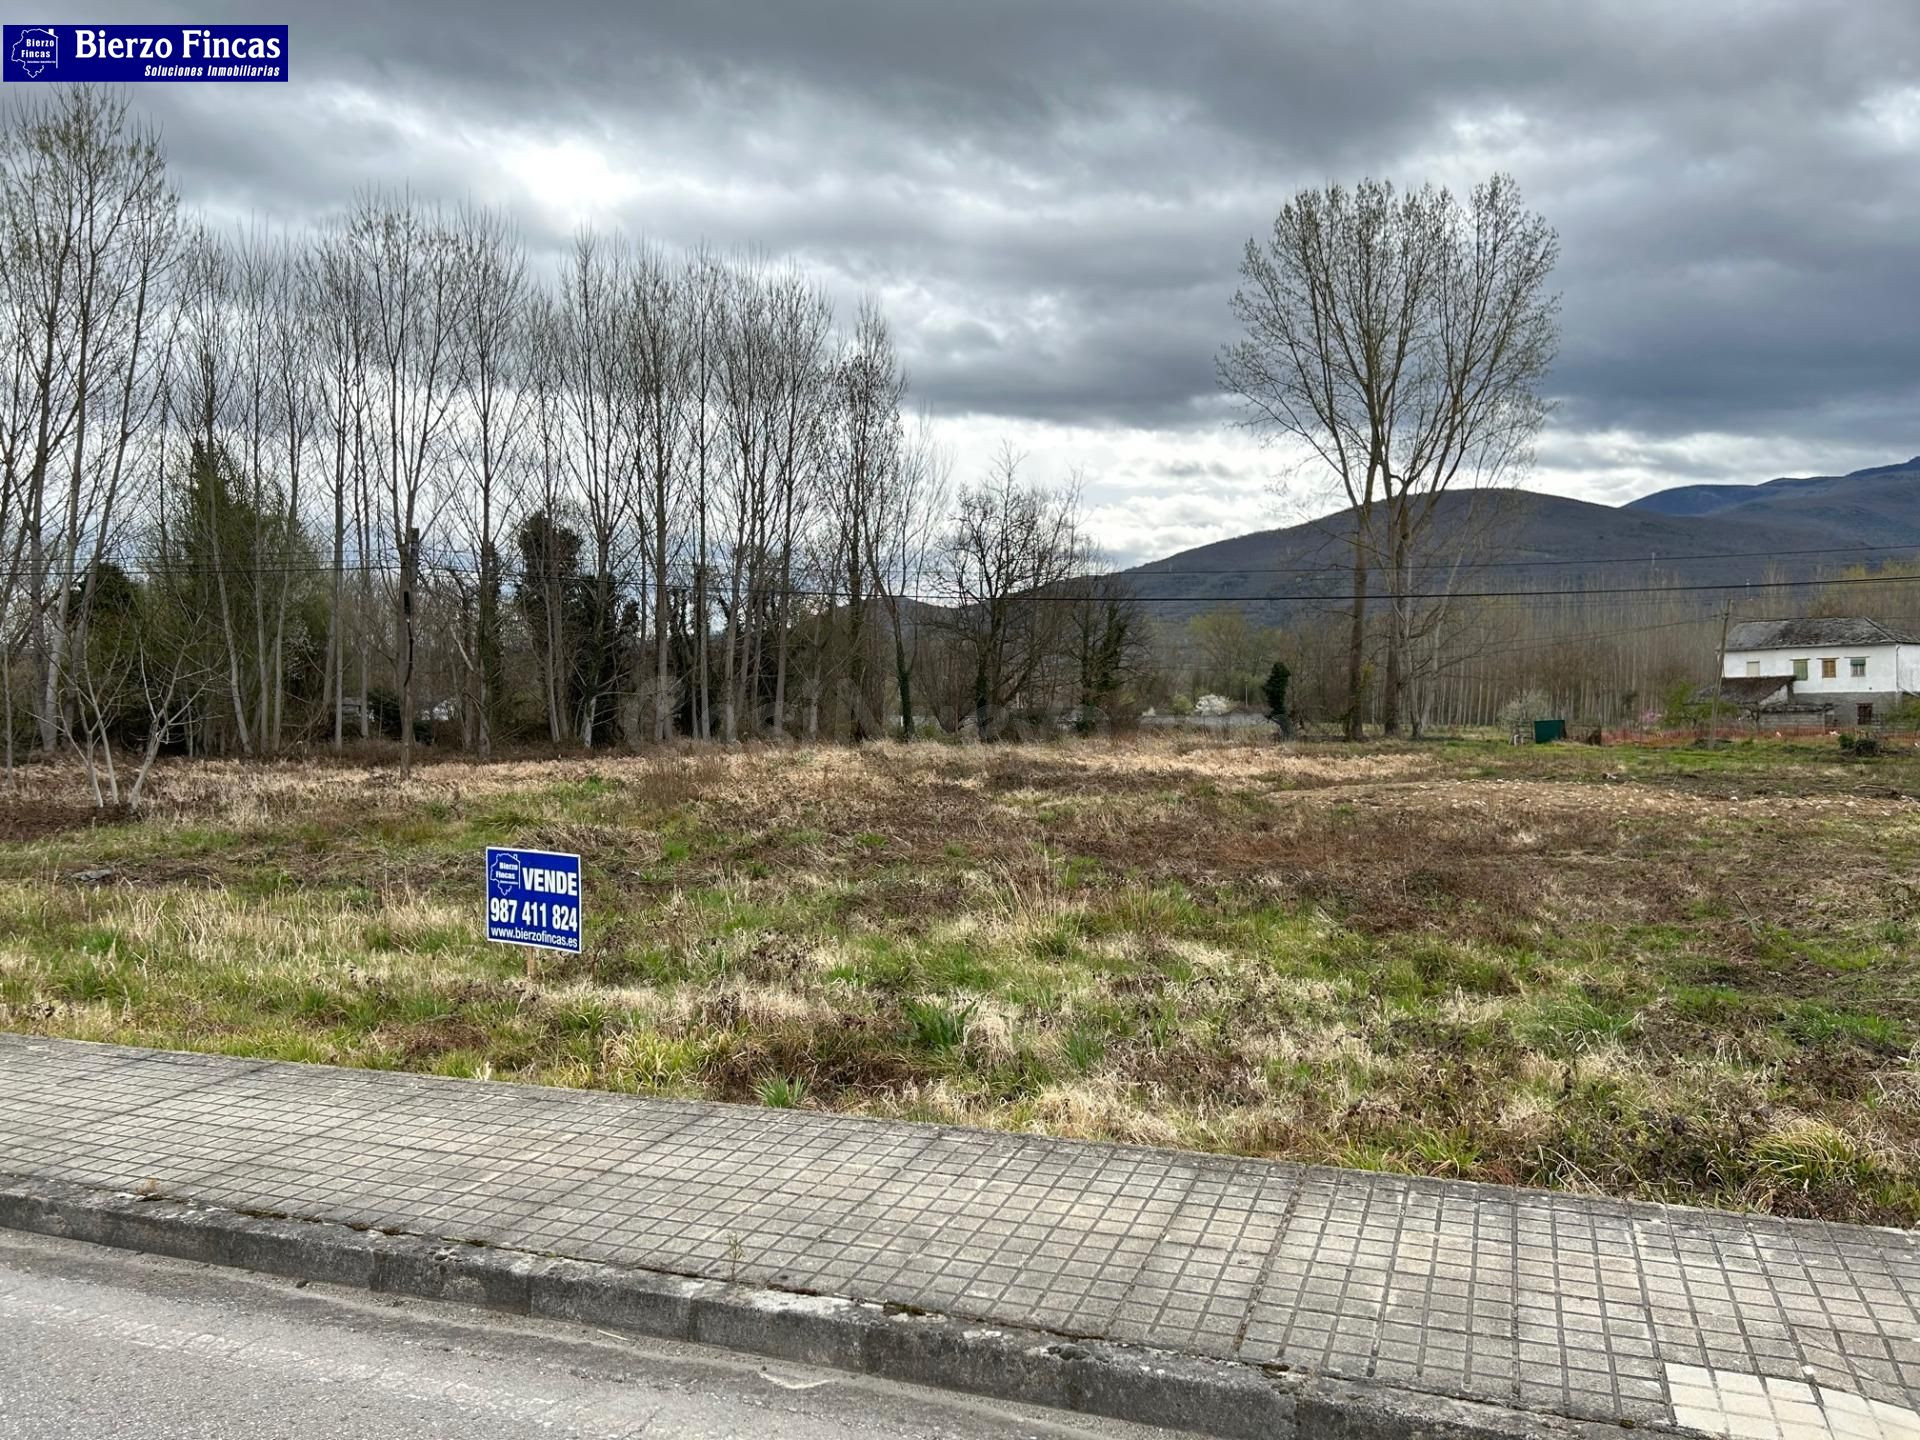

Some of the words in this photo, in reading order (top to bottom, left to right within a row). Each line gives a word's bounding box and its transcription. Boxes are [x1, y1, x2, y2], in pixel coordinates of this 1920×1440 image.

[522, 867, 578, 896] VENDE
[490, 897, 517, 923] 987
[521, 901, 547, 928] 411
[552, 904, 577, 932] 824
[490, 926, 578, 948] www.bierzofincas.es
